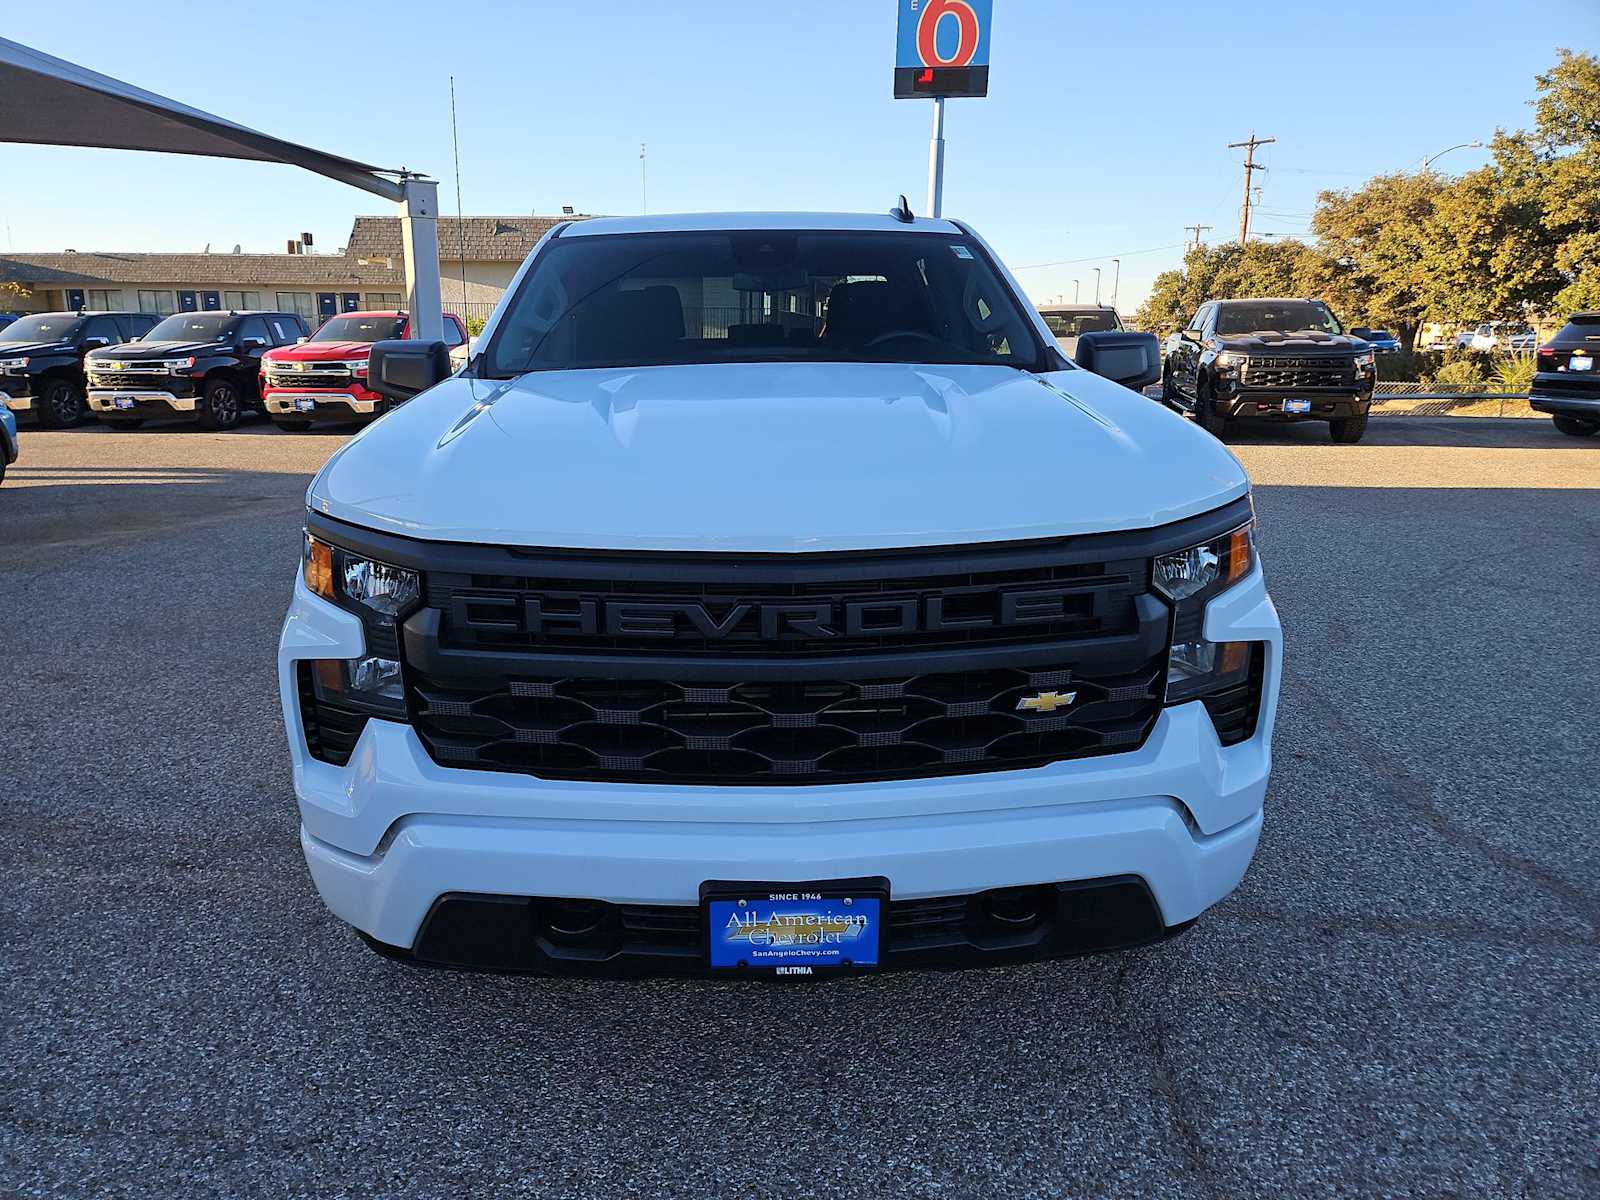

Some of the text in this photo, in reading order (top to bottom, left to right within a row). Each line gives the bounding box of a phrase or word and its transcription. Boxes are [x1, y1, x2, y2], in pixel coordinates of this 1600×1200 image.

[916, 0, 979, 67] 6
[450, 576, 1131, 640] CHEVROLET
[726, 911, 868, 928] All American
[748, 927, 842, 945] Chevrolet
[784, 966, 813, 975] LITHIA
